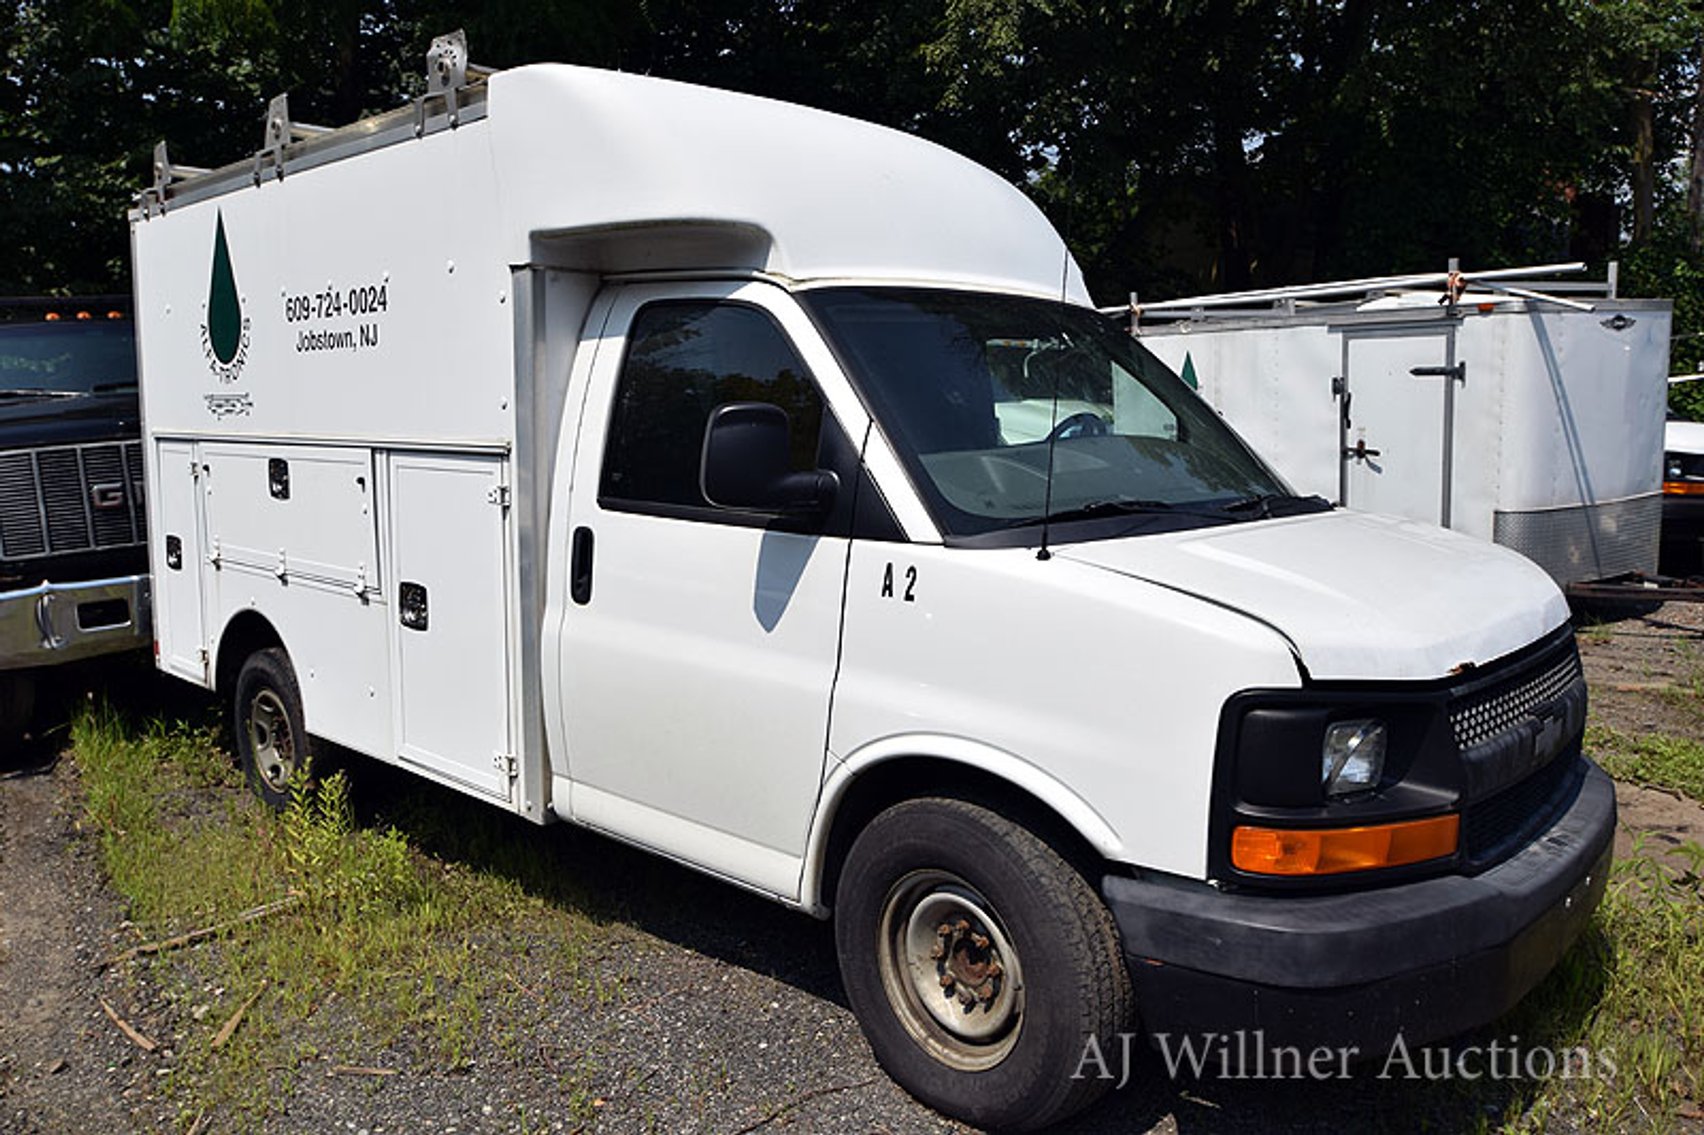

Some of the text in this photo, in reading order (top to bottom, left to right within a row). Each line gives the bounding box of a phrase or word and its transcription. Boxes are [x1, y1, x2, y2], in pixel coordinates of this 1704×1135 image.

[286, 285, 387, 322] 609-724-0024
[296, 323, 378, 352] Jobstown, NJ
[881, 562, 917, 602] A 2
